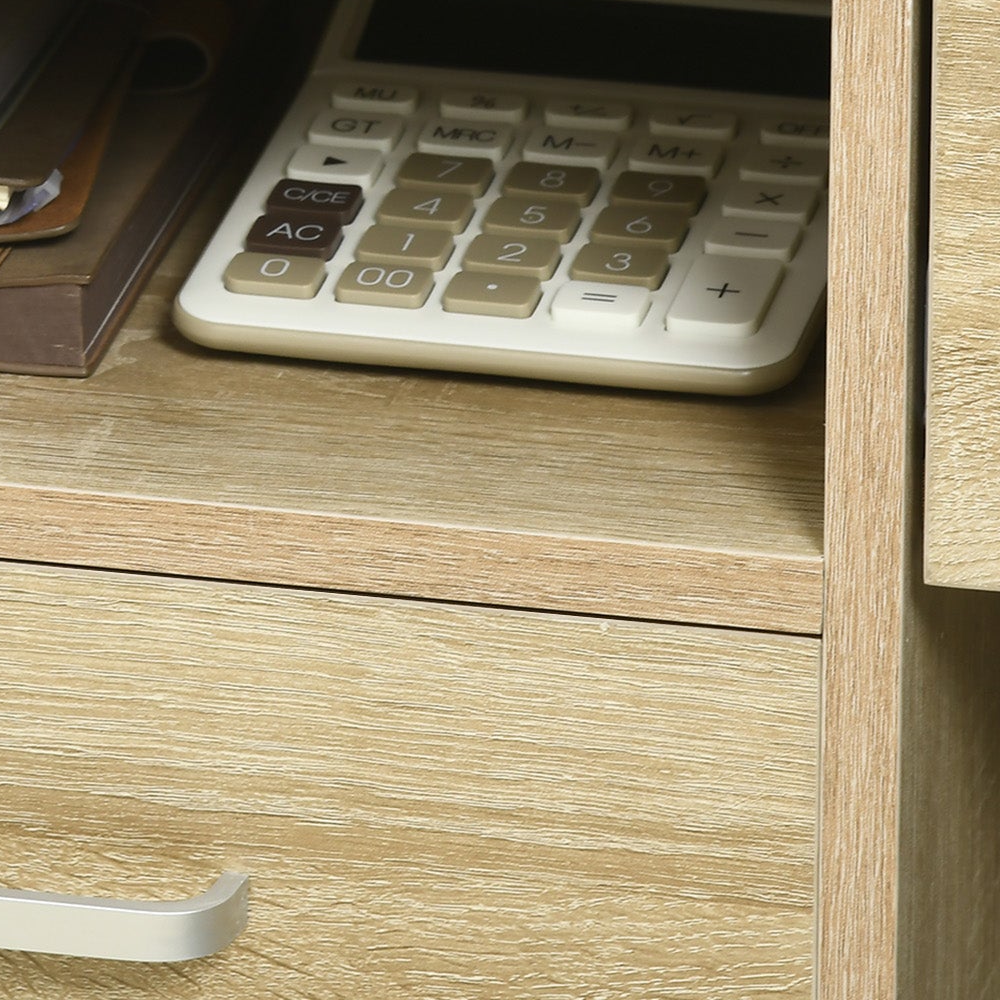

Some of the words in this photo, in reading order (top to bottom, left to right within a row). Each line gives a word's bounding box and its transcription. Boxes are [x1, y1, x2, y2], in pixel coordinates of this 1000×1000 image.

[353, 86, 396, 99] MU
[331, 118, 381, 134] GT
[432, 126, 497, 142] MRC
[648, 143, 702, 159] M+
[436, 160, 464, 179] 7
[539, 170, 567, 189] 8
[648, 180, 674, 197] 9
[283, 186, 351, 205] C/CE
[413, 197, 442, 215] 4
[519, 205, 547, 225] 5
[266, 221, 324, 242] AC
[625, 215, 653, 235] 6
[400, 232, 416, 252] 1
[496, 242, 528, 264] 2
[604, 252, 632, 272] 3
[259, 258, 291, 277] 0
[356, 266, 414, 288] 00
